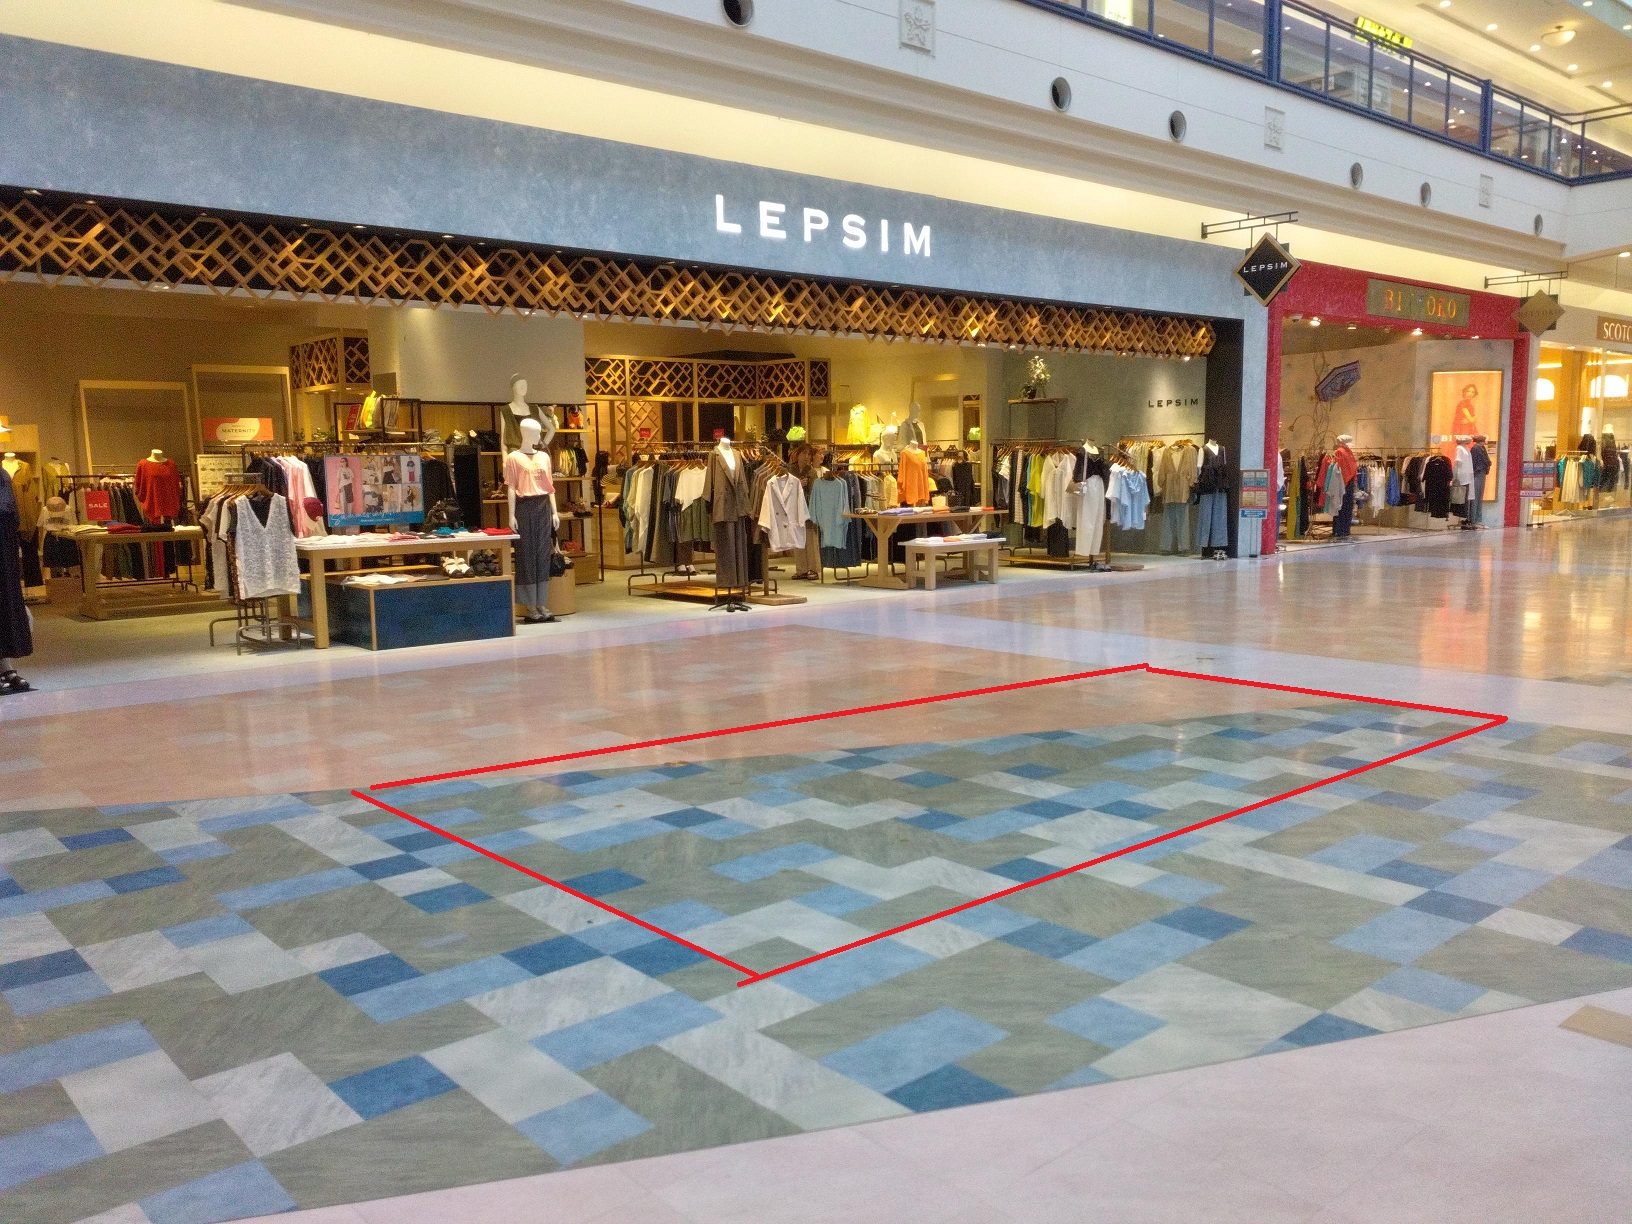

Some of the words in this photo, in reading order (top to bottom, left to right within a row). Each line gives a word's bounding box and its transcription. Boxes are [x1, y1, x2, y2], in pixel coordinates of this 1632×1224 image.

[715, 194, 931, 257] LEPSIM
[1243, 262, 1288, 273] LEPSIM
[1603, 322, 1632, 342] SCOTC
[1148, 398, 1199, 408] LEPSIM
